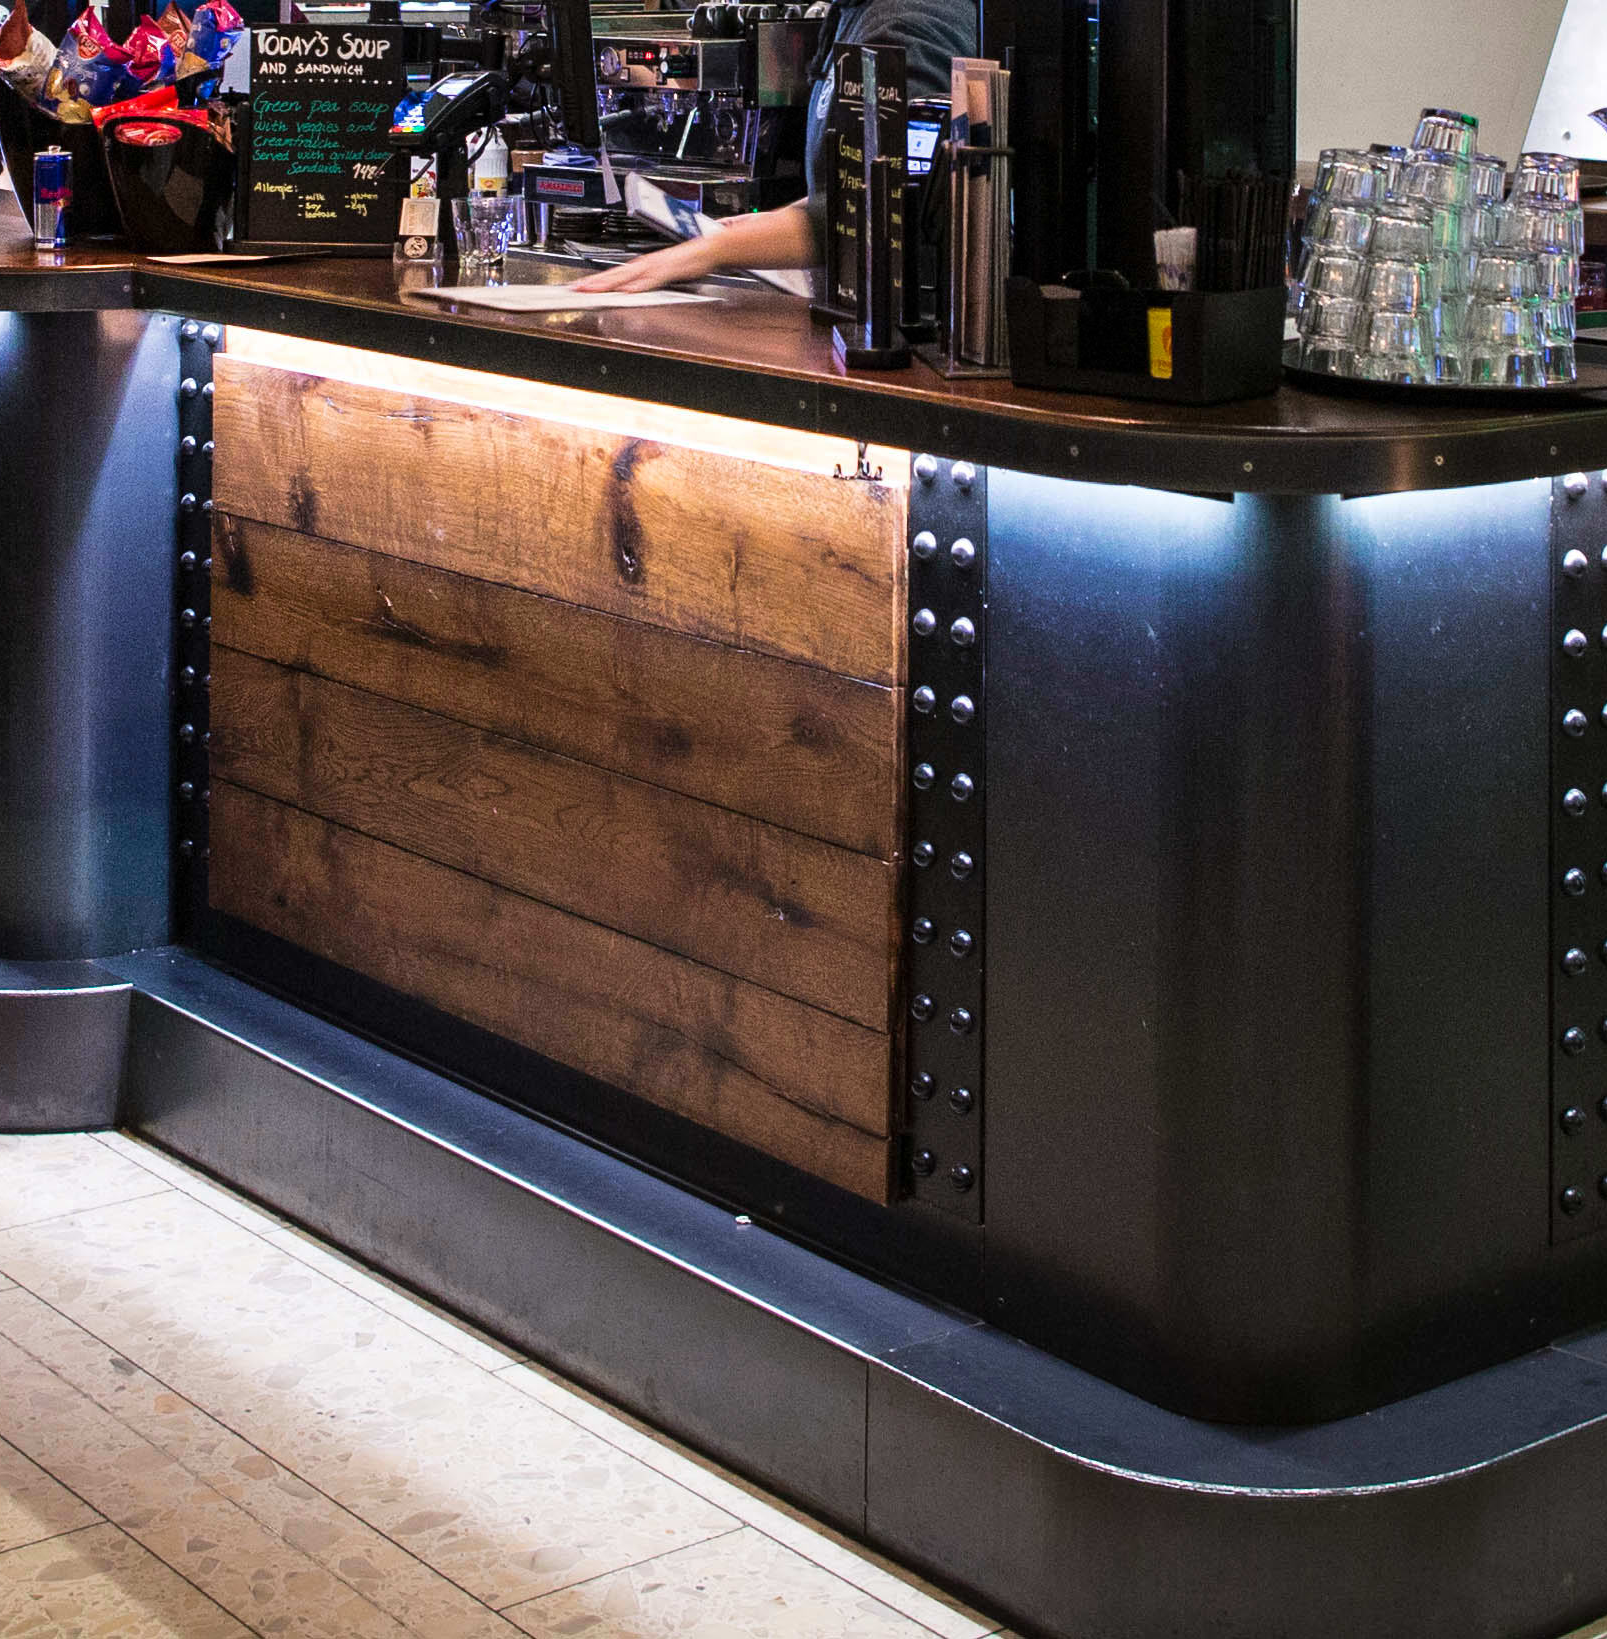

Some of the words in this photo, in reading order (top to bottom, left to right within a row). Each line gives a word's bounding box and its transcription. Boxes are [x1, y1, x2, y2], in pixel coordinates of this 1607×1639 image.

[252, 28, 330, 58] TODAY'S
[336, 32, 391, 60] SOUP
[259, 61, 287, 75] AND
[253, 91, 302, 120] Green
[306, 100, 341, 120] pea
[348, 101, 391, 119] soup
[253, 120, 289, 132] with
[252, 150, 290, 162] Served
